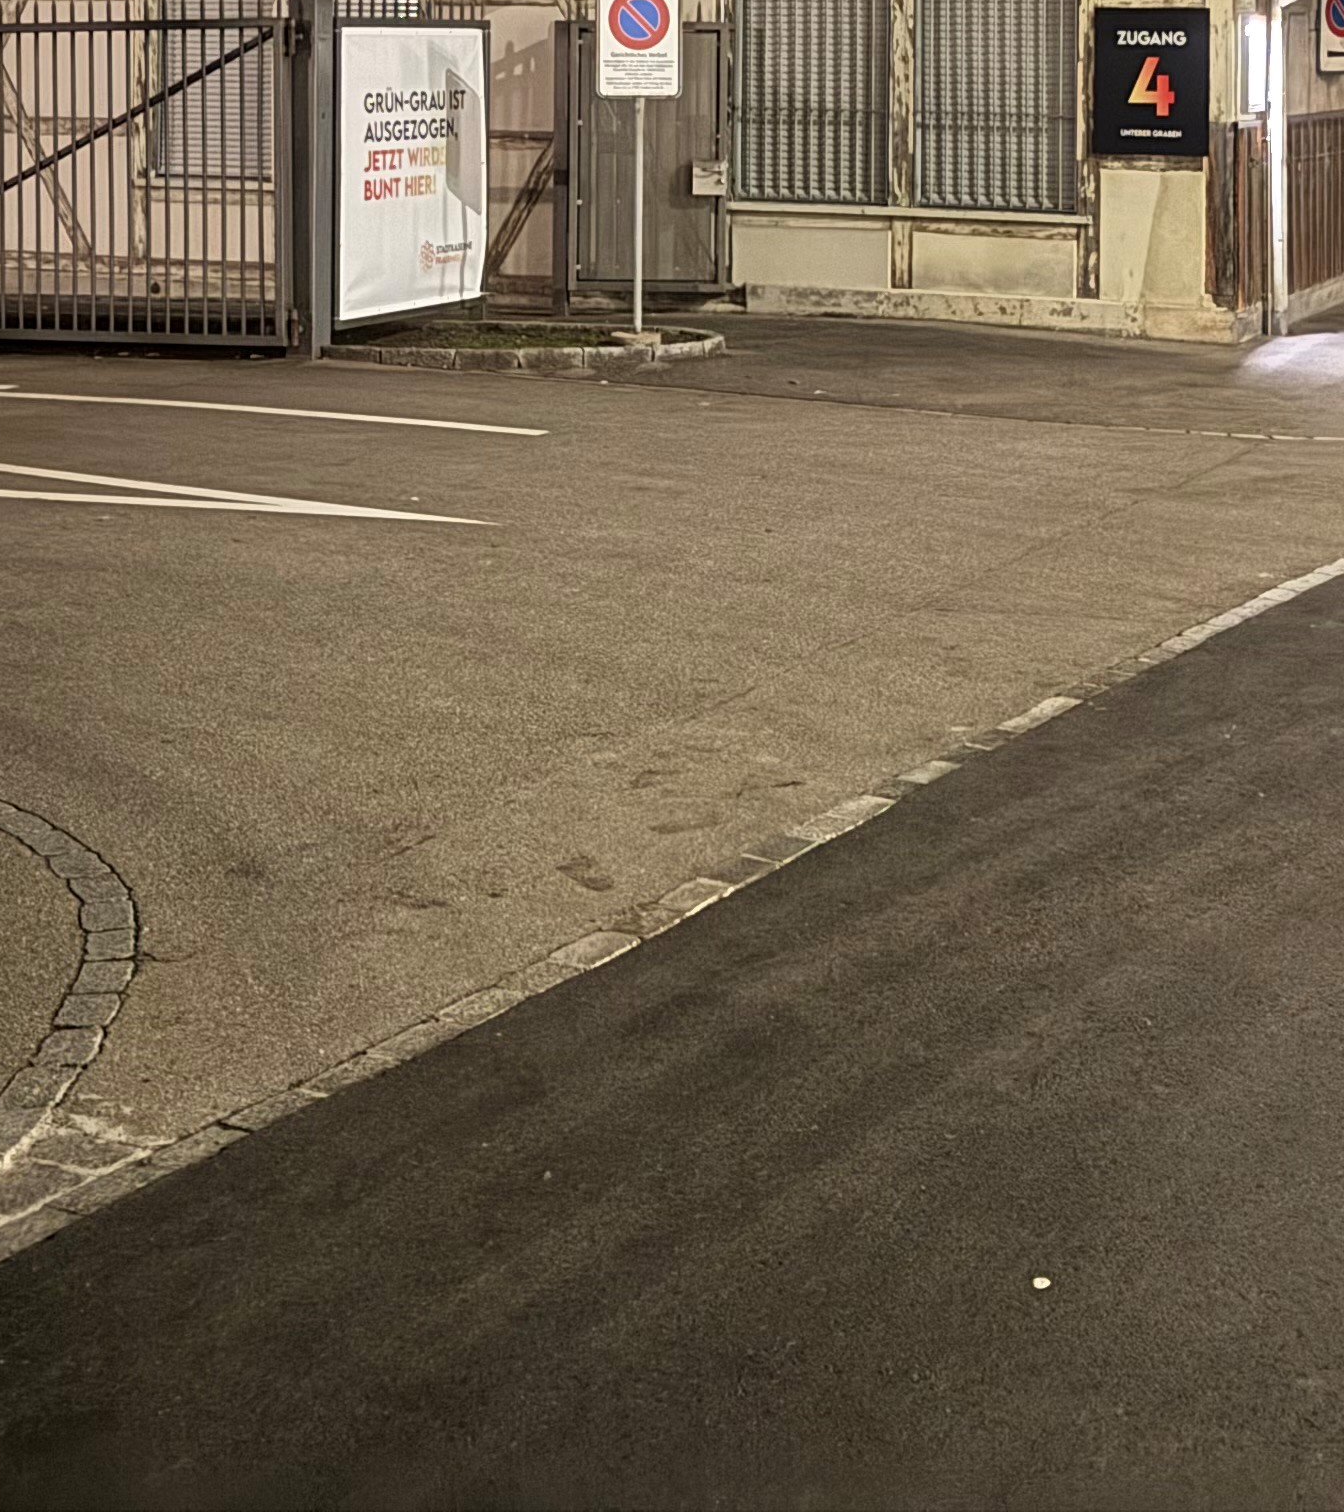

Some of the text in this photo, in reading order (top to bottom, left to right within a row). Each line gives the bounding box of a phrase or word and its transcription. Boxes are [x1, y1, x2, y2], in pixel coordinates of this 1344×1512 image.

[1116, 29, 1188, 47] ZUGANG
[1127, 56, 1175, 117] 4
[364, 87, 466, 114] GRÜN-GRAU IST
[364, 117, 458, 143] AUSGEZOGEN,
[1120, 128, 1183, 139] UNTERER GRABEN
[364, 148, 404, 173] JETZT
[364, 174, 437, 202] BUNT HIER!
